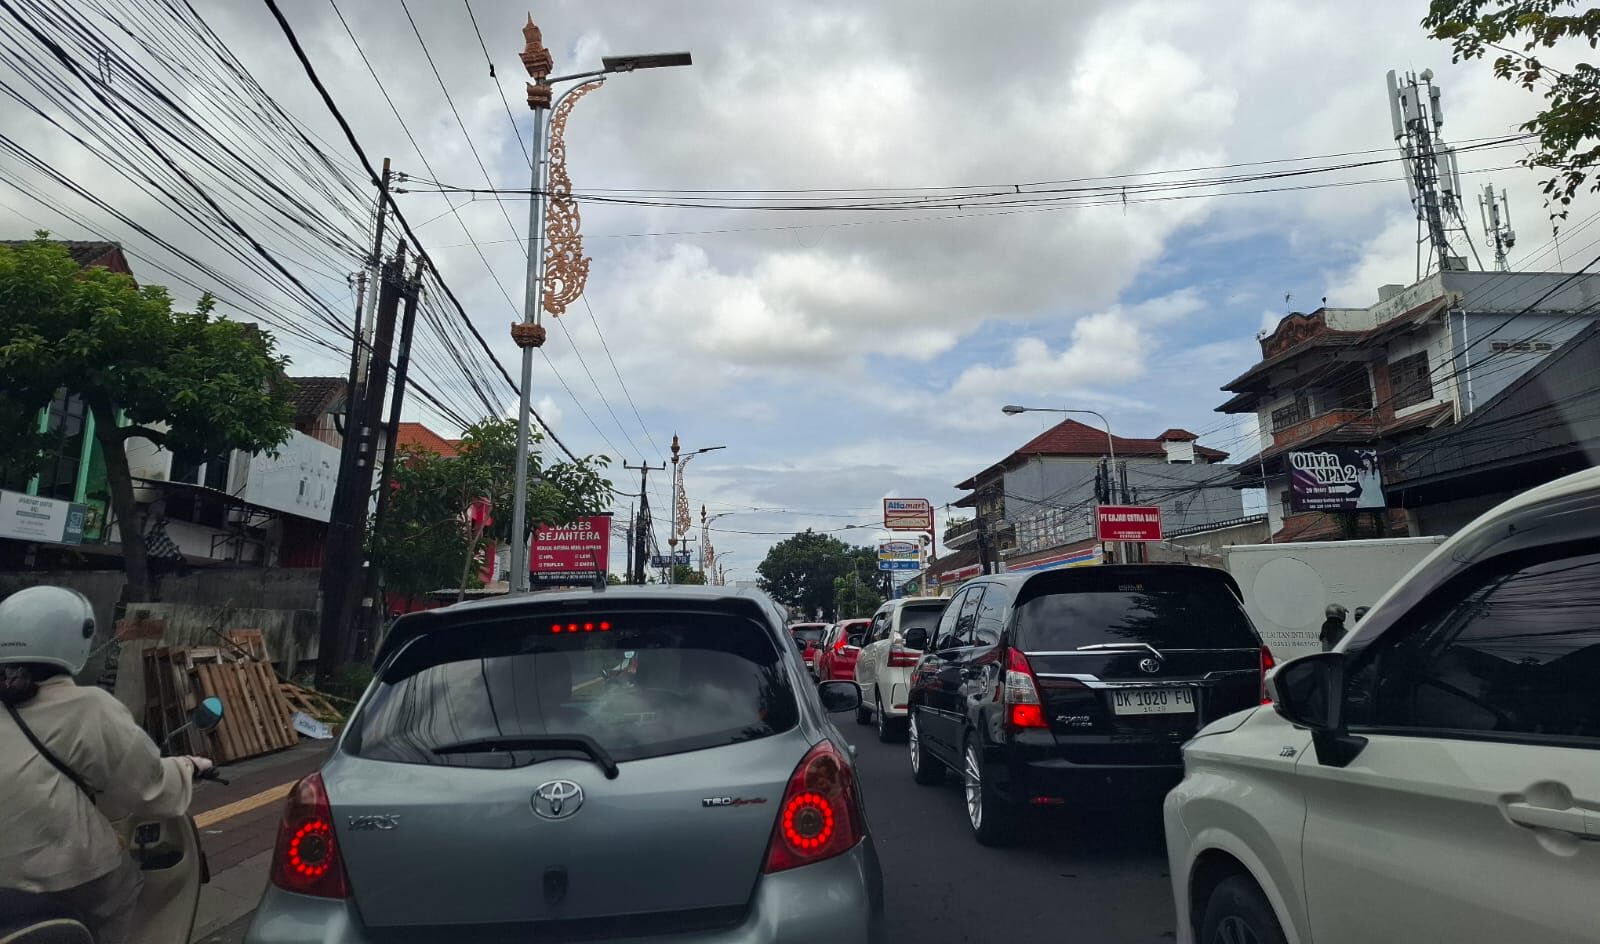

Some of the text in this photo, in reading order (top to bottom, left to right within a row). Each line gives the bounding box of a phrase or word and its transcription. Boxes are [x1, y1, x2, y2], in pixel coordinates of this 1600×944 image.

[1293, 452, 1339, 469] Olivia
[1315, 465, 1358, 483] SPA 2
[539, 531, 600, 541] SEJAHTERA
[1116, 692, 1132, 706] DK
[1136, 691, 1168, 705] 1020
[703, 797, 732, 807] TRD
